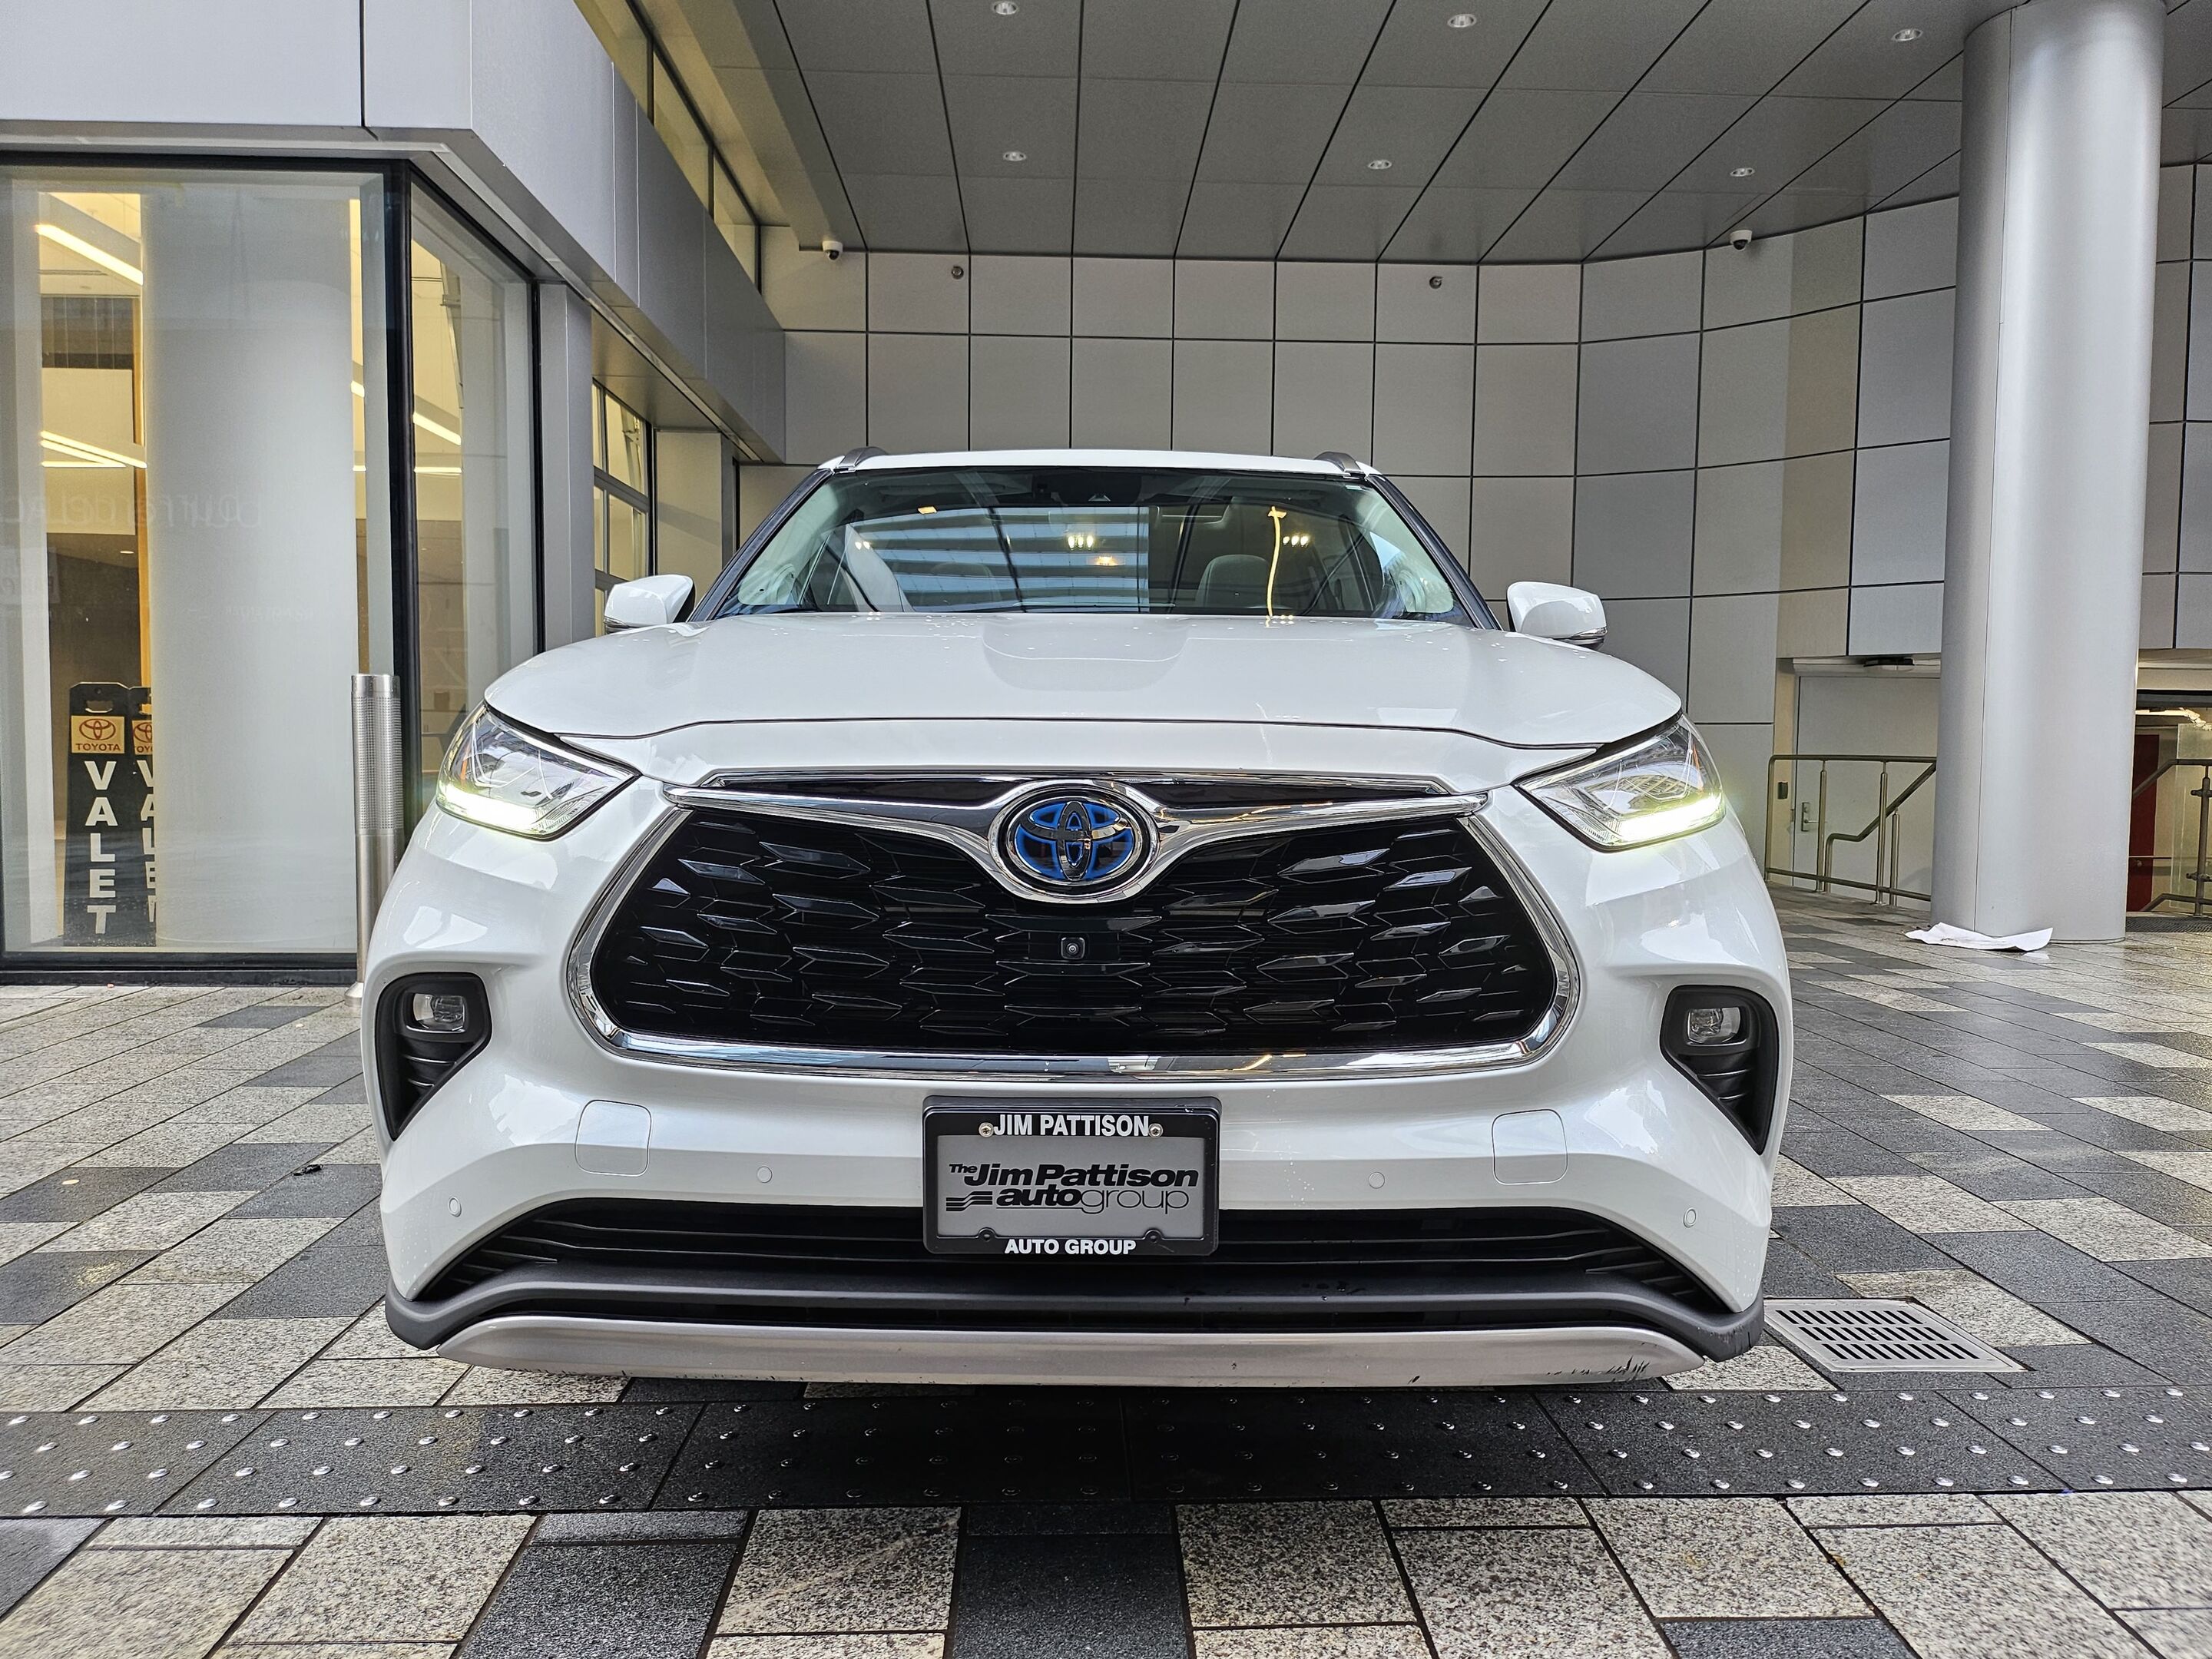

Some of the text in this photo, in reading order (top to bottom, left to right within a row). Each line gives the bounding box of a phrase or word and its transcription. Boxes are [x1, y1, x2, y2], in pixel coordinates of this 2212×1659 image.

[75, 743, 121, 752] TOYOTA
[84, 760, 118, 935] VALET
[993, 1114, 1150, 1137] JIM PATTISON
[949, 1163, 978, 1174] The
[1035, 1163, 1199, 1187] Pattison
[1004, 1238, 1137, 1256] AUTO GROUP
